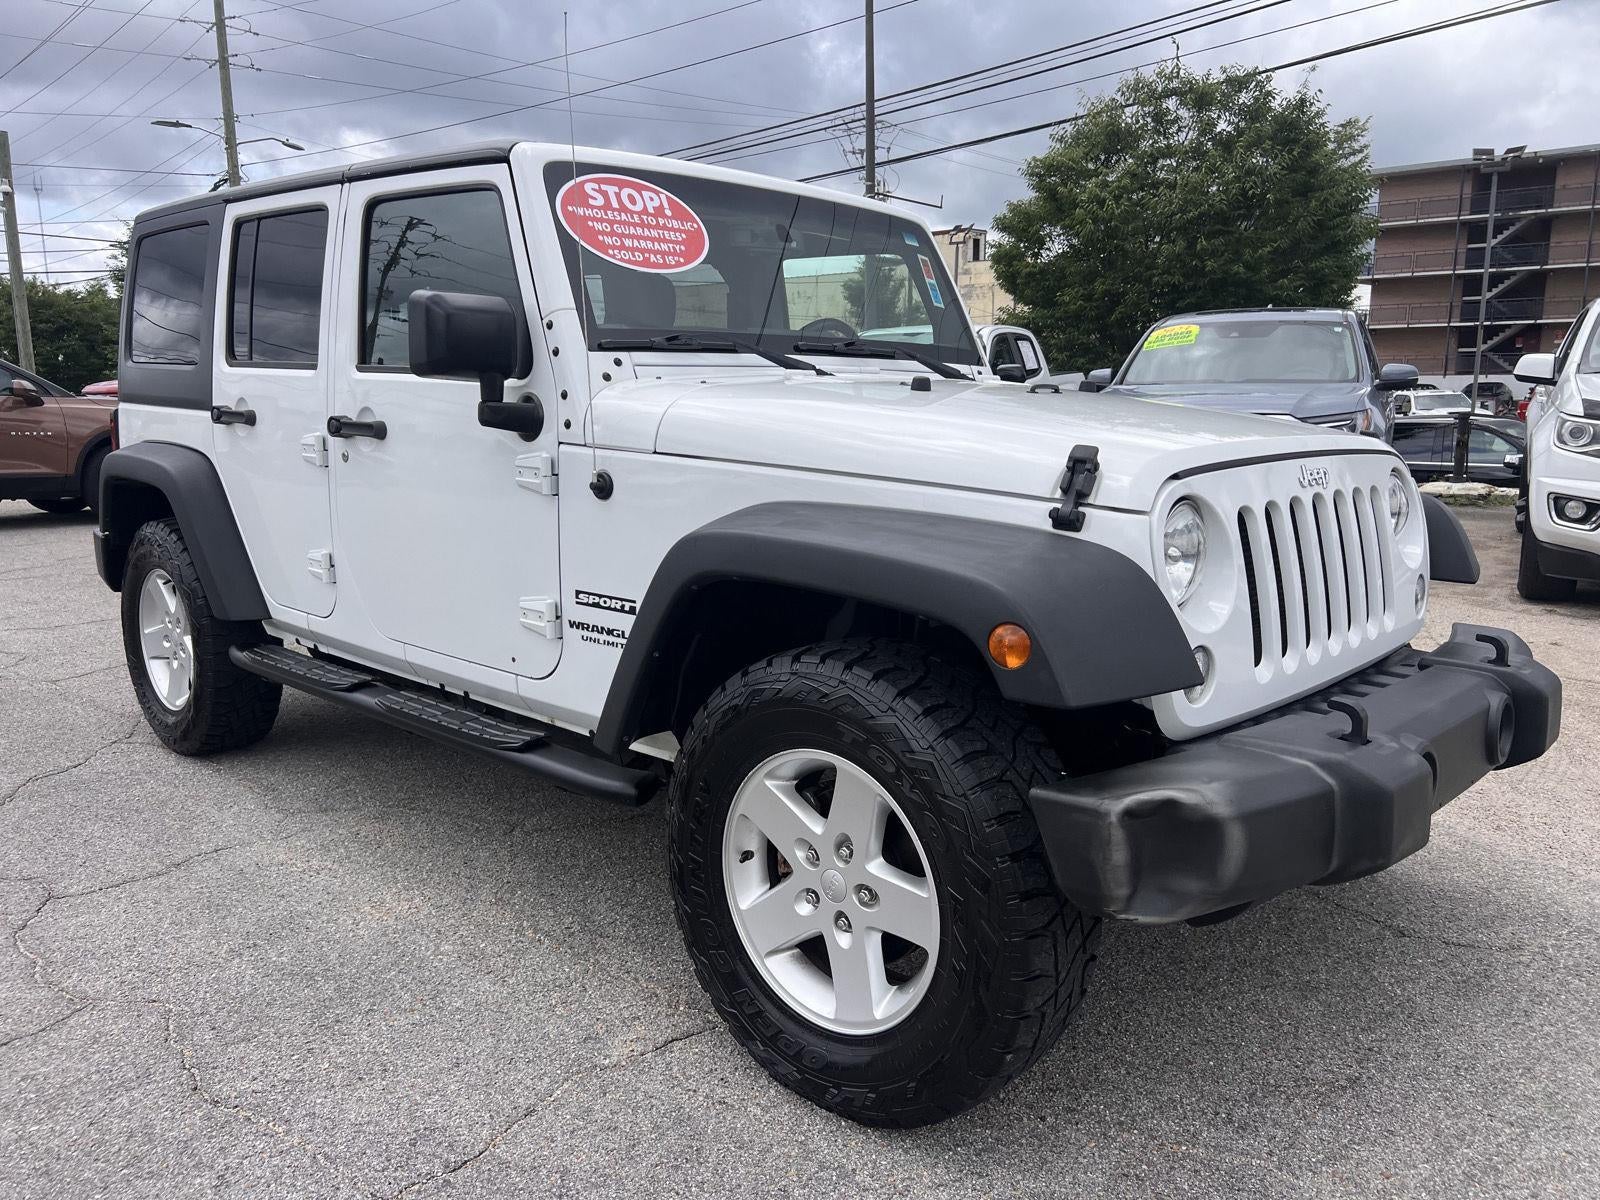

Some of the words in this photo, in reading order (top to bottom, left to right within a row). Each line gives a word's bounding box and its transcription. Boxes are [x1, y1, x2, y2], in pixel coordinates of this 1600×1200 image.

[583, 182, 672, 216] STOP!
[641, 215, 656, 226] TO
[1298, 464, 1329, 489] Jeep
[576, 593, 637, 612] SPORT
[836, 721, 946, 850] TOYO
